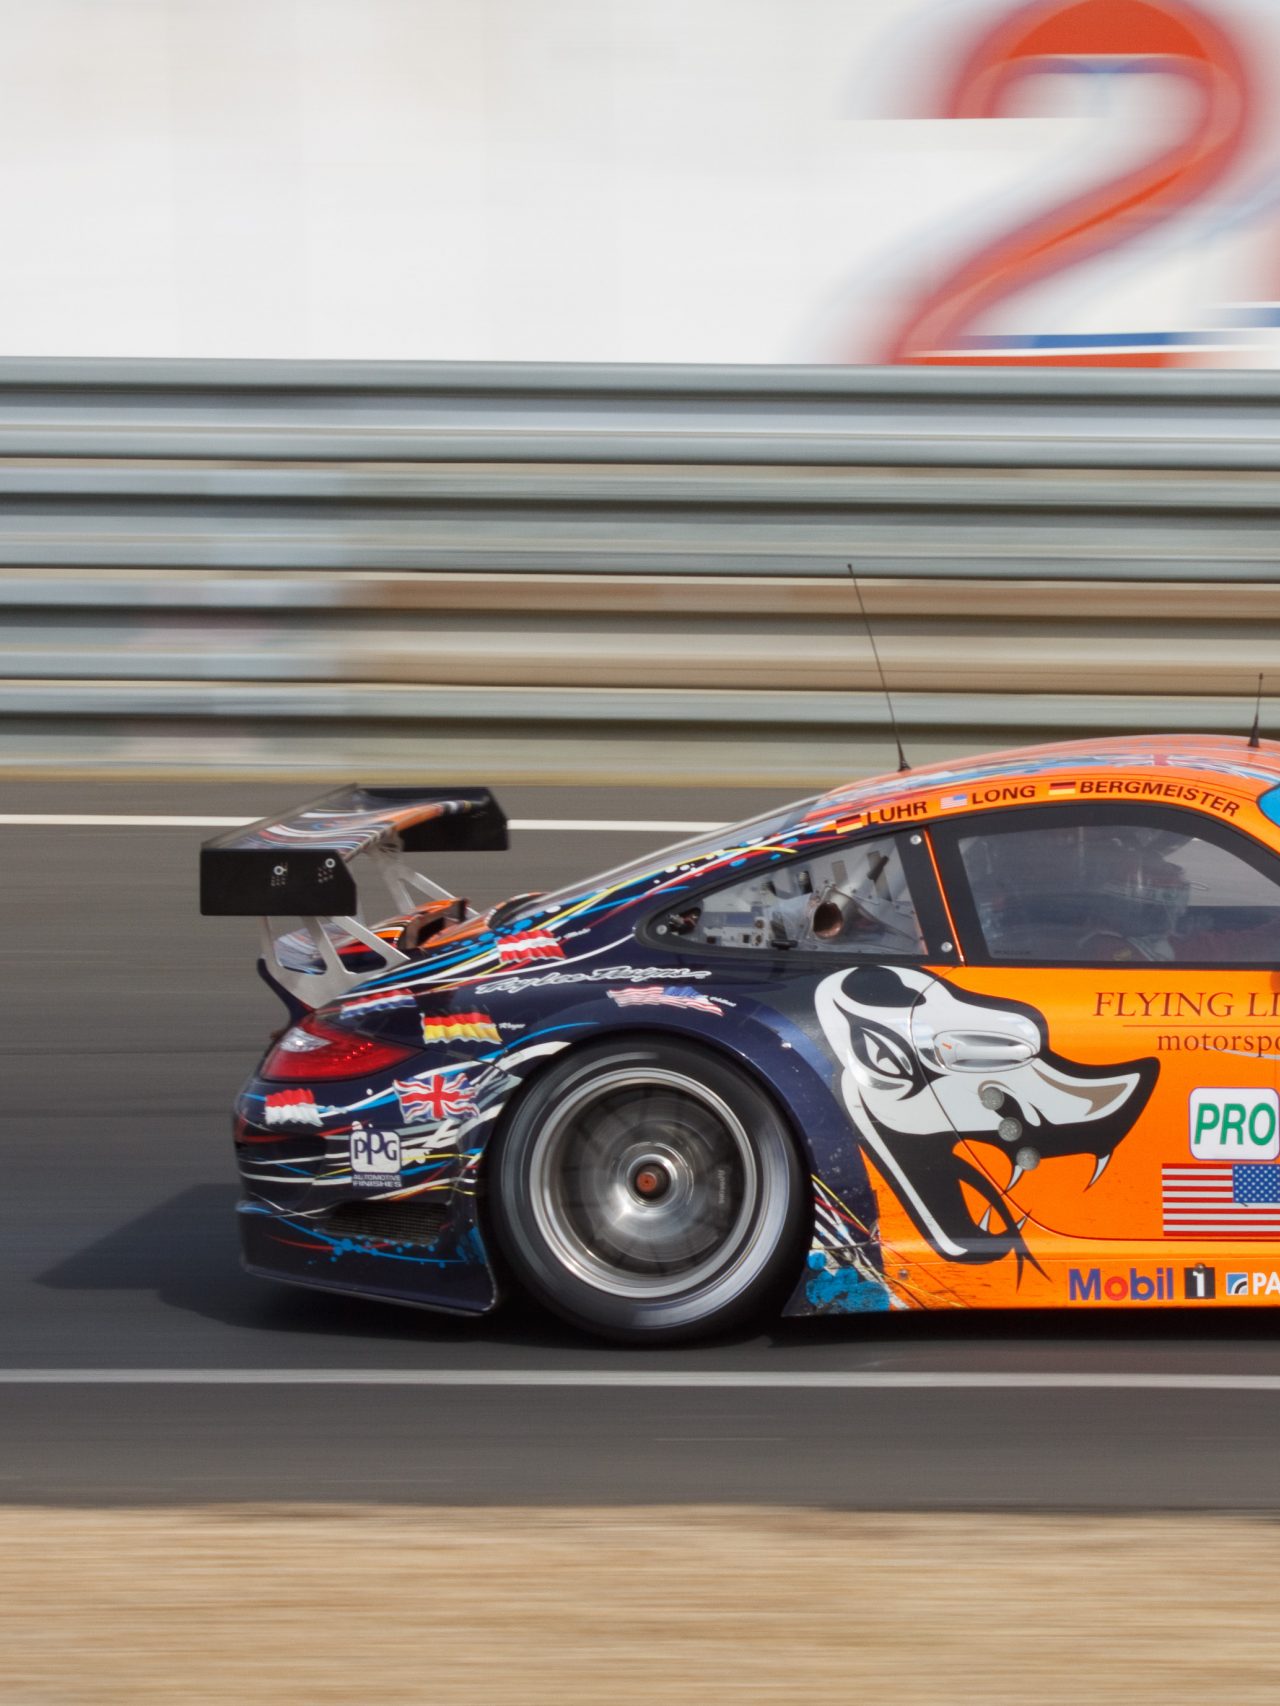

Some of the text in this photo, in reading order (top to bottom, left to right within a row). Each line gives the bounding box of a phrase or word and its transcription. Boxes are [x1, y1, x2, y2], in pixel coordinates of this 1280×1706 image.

[865, 781, 1241, 825] LUHR LONG BERGMEISTER
[1093, 992, 1235, 1017] FLYING
[1193, 1102, 1276, 1146] PRO
[354, 1131, 398, 1165] PPG
[1069, 1267, 1206, 1301] Mobil 1
